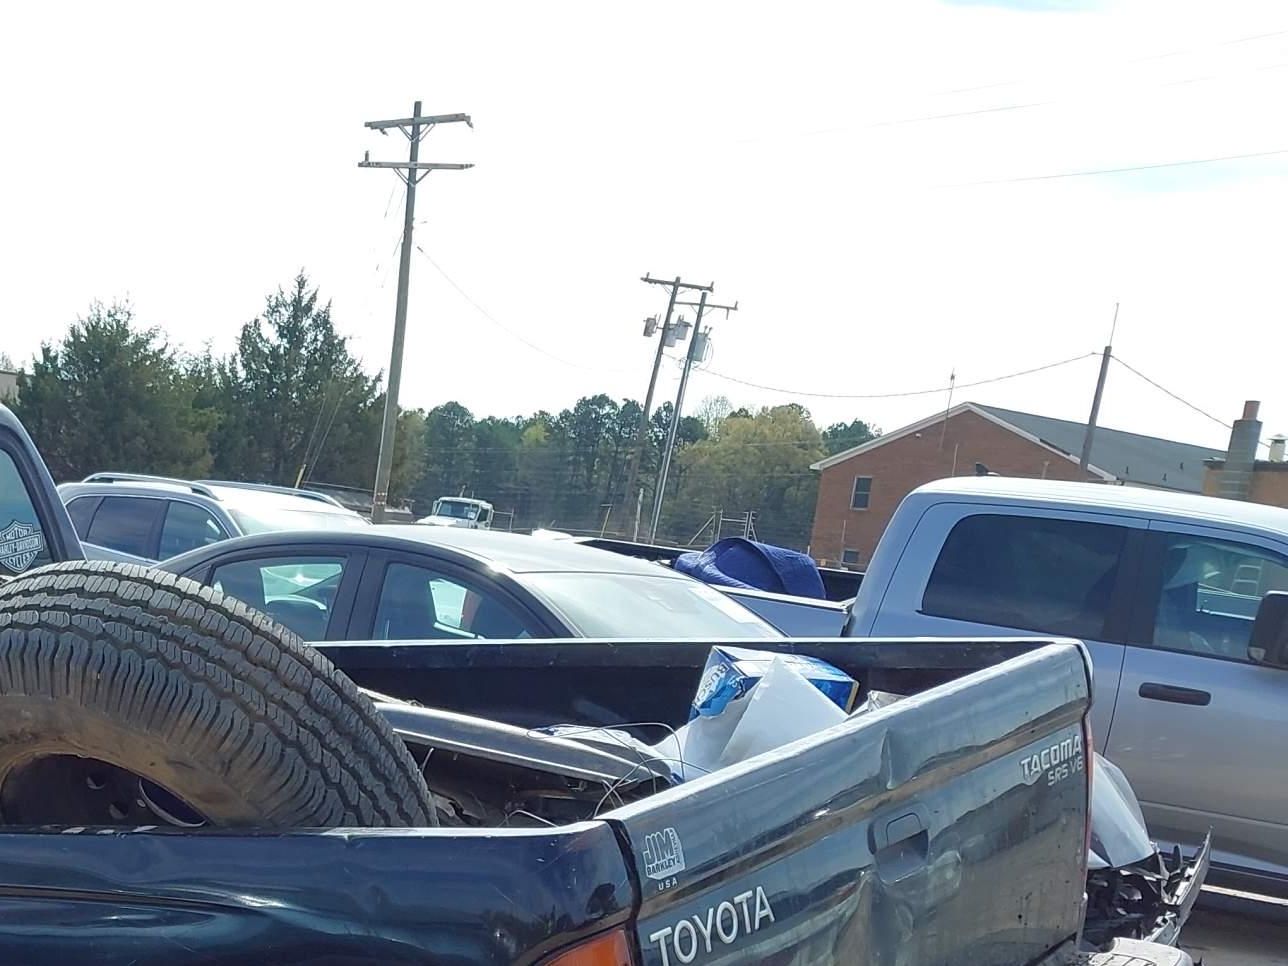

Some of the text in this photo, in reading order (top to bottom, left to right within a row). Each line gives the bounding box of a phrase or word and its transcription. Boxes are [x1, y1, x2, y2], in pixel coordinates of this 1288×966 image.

[5, 527, 29, 541] MOTOR
[1020, 735, 1082, 780] TACOMA
[1047, 755, 1083, 786] SR5 V6
[643, 828, 675, 866] JIM
[646, 857, 676, 876] BARKLEY
[658, 877, 678, 891] USA
